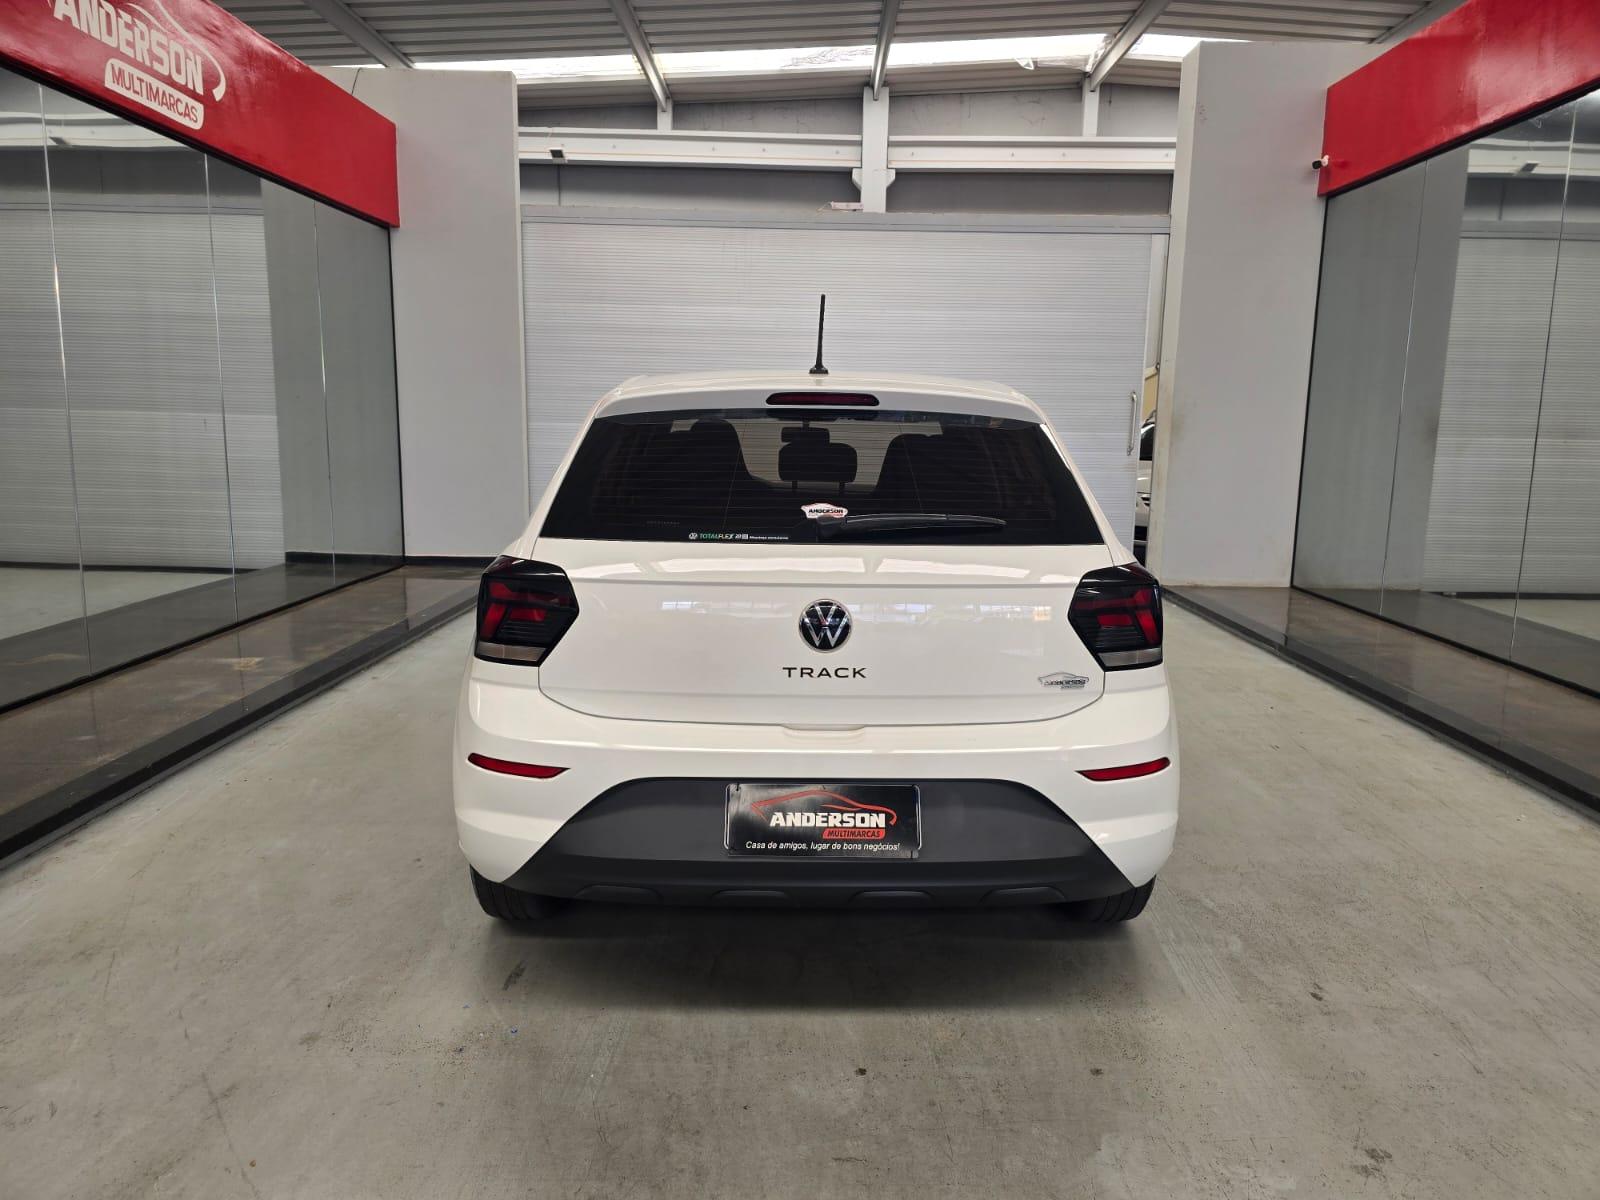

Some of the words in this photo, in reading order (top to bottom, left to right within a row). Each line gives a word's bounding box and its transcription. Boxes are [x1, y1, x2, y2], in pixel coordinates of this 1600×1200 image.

[53, 0, 204, 95] ANDERSON
[111, 62, 199, 124] MULTIMARCAS
[782, 666, 867, 679] TRACK
[769, 811, 886, 828] ANDERSON
[826, 828, 882, 838] MULTIMARCAS
[745, 840, 766, 849] Casa
[767, 841, 777, 849] de
[778, 841, 809, 851] amigos,
[810, 841, 830, 851] lugar
[831, 841, 842, 850] de
[843, 841, 862, 850] bons
[863, 842, 901, 852] negócios!
